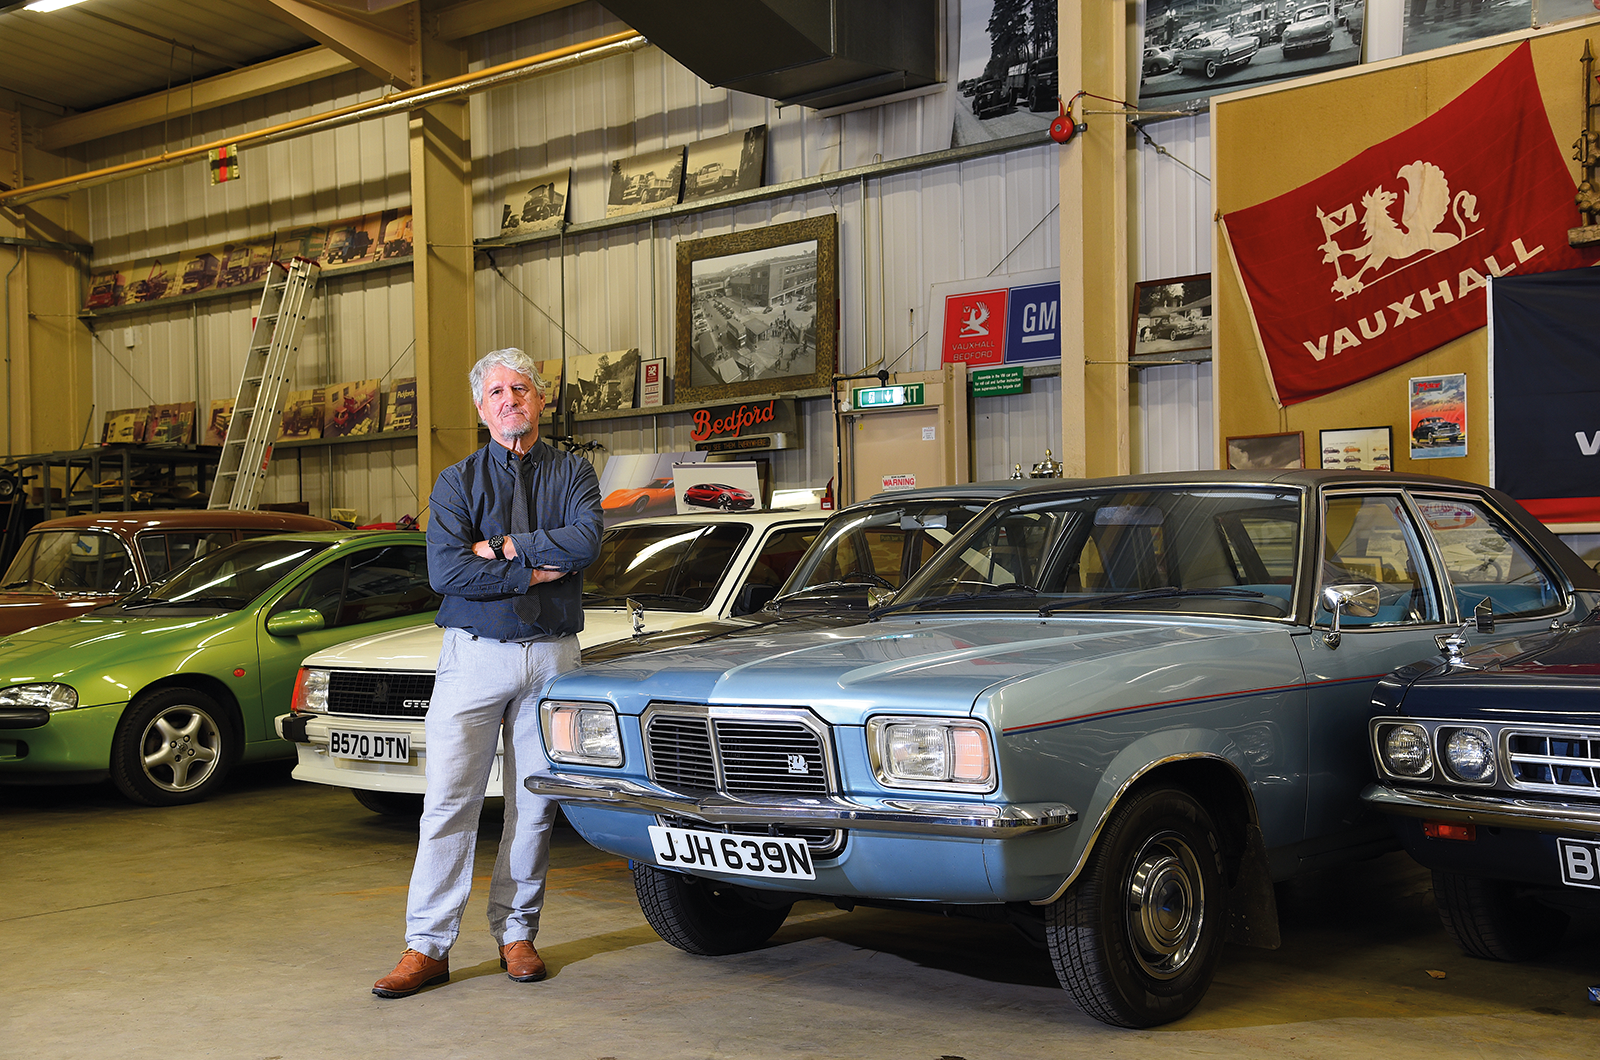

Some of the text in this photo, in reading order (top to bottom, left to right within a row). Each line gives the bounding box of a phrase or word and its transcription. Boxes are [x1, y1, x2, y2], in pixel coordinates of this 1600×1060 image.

[1303, 238, 1545, 362] VAUXHALL
[1022, 300, 1058, 333] GM
[952, 340, 995, 350] VAUXHALL
[953, 350, 993, 361] BEDFORD
[690, 400, 774, 442] Bedford
[738, 439, 766, 448] EVERYWHERE
[883, 478, 914, 486] WARNING
[331, 732, 407, 759] B570 DTN
[660, 832, 812, 874] JJH 639N
